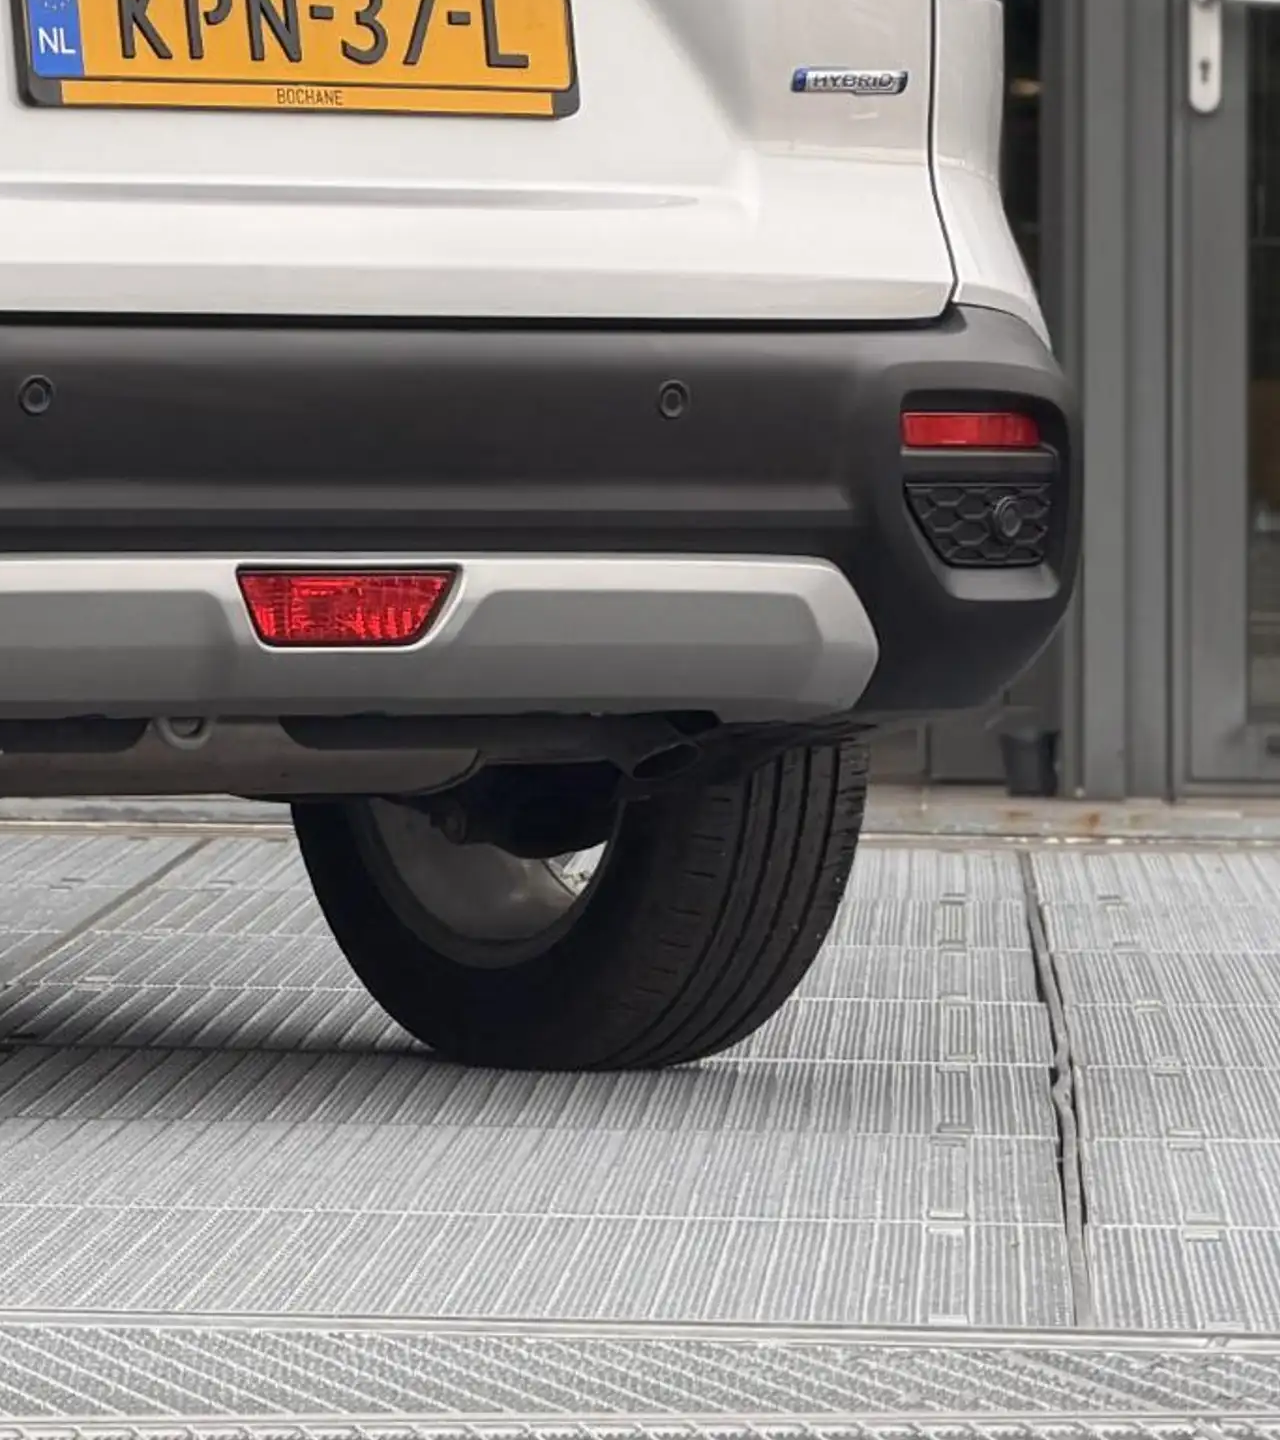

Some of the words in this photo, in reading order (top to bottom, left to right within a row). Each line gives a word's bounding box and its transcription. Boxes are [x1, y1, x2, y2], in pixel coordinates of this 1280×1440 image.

[38, 26, 76, 54] NL
[813, 73, 894, 88] HYBRID
[276, 87, 345, 106] BOCHANE
